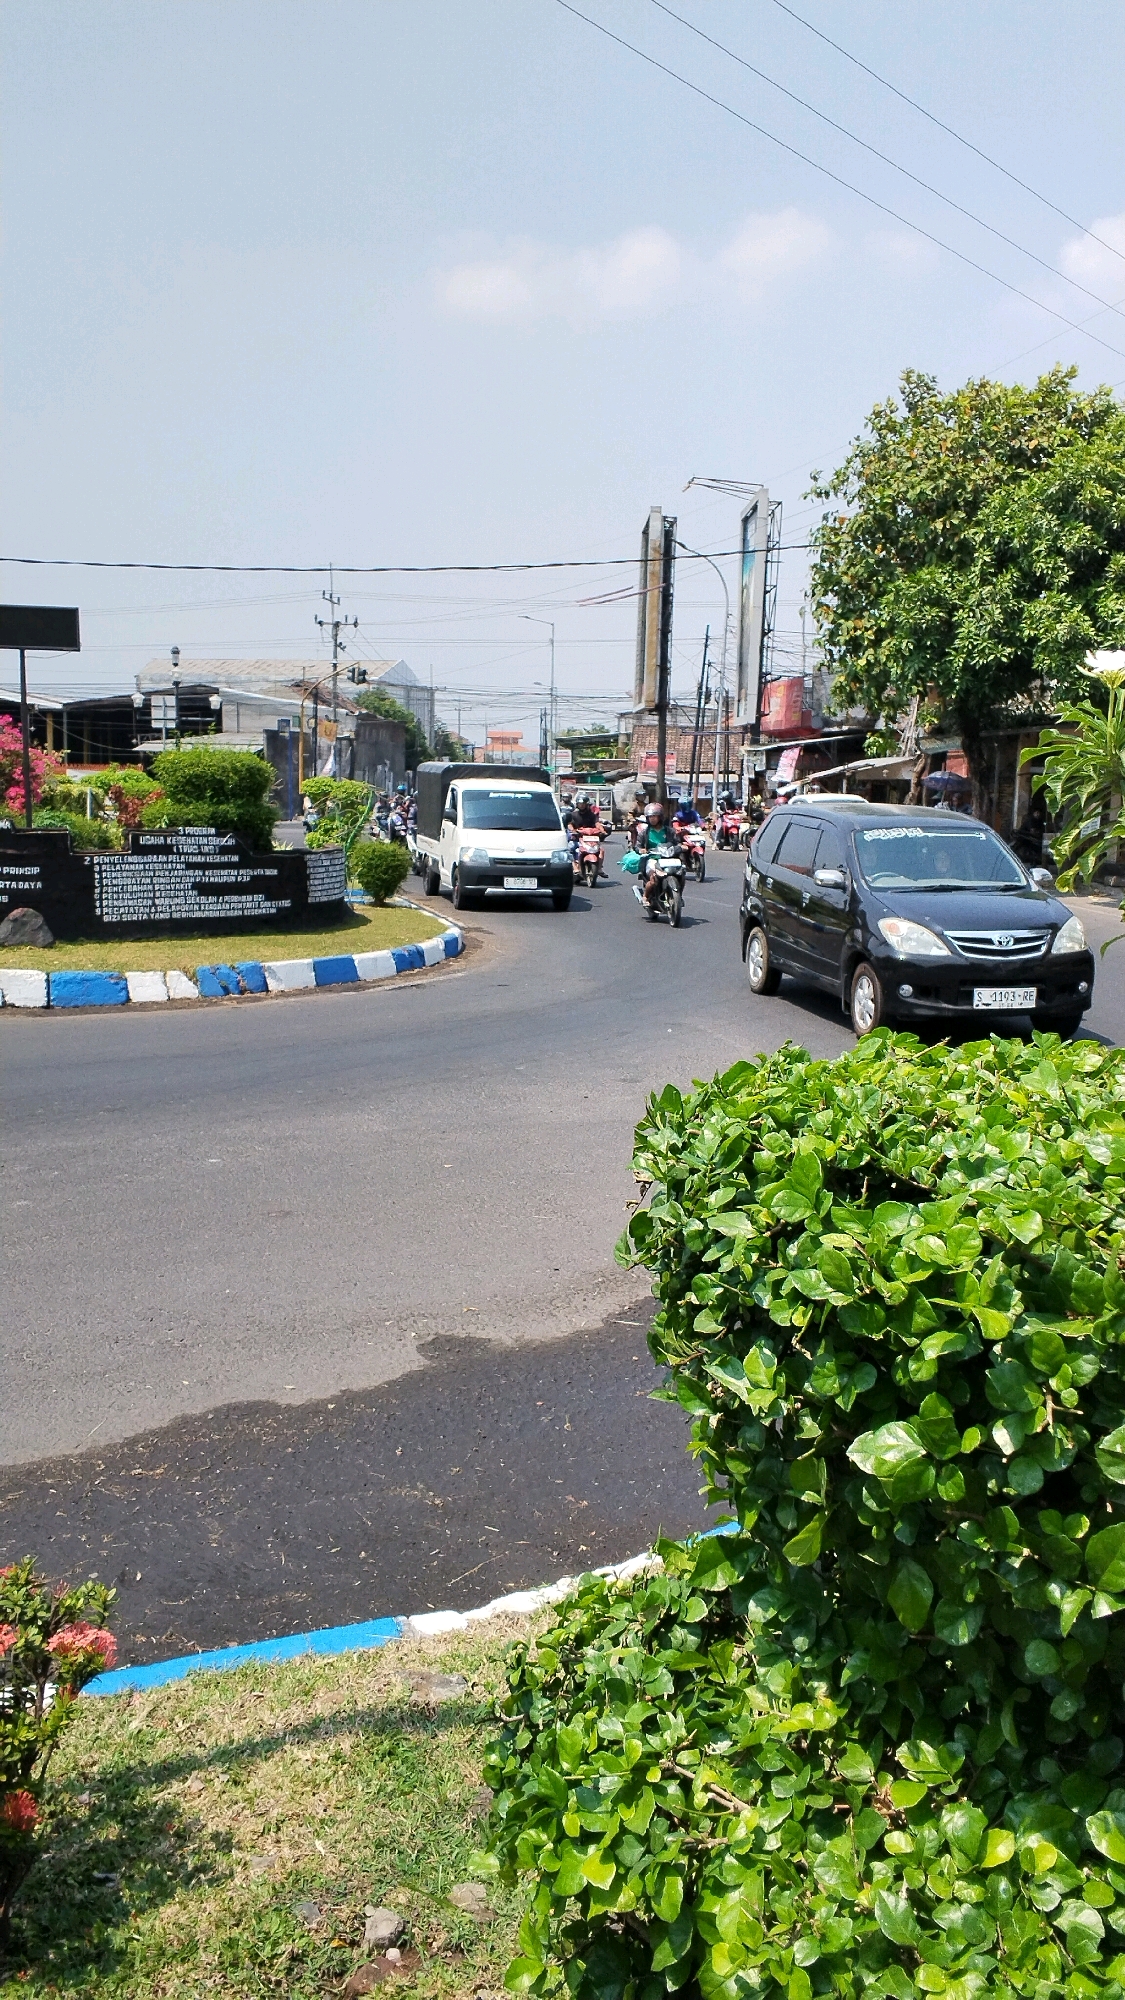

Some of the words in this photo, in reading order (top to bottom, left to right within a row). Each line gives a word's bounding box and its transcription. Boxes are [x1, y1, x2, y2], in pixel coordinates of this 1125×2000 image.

[140, 836, 165, 845] USAHA
[167, 836, 208, 846] KESEHATAN
[2, 866, 40, 875] PRINSIP
[101, 863, 144, 871] PELAYANAN
[102, 870, 154, 878] PEMERIKSAAN
[154, 883, 193, 891] PENYAKIT
[102, 891, 154, 900] PENYULUHAN
[155, 889, 198, 898] KESEHATAN
[186, 895, 217, 904] SEKOLAH
[976, 991, 983, 1002] S
[992, 991, 1016, 1002] 1193
[1022, 990, 1035, 1001] RE
